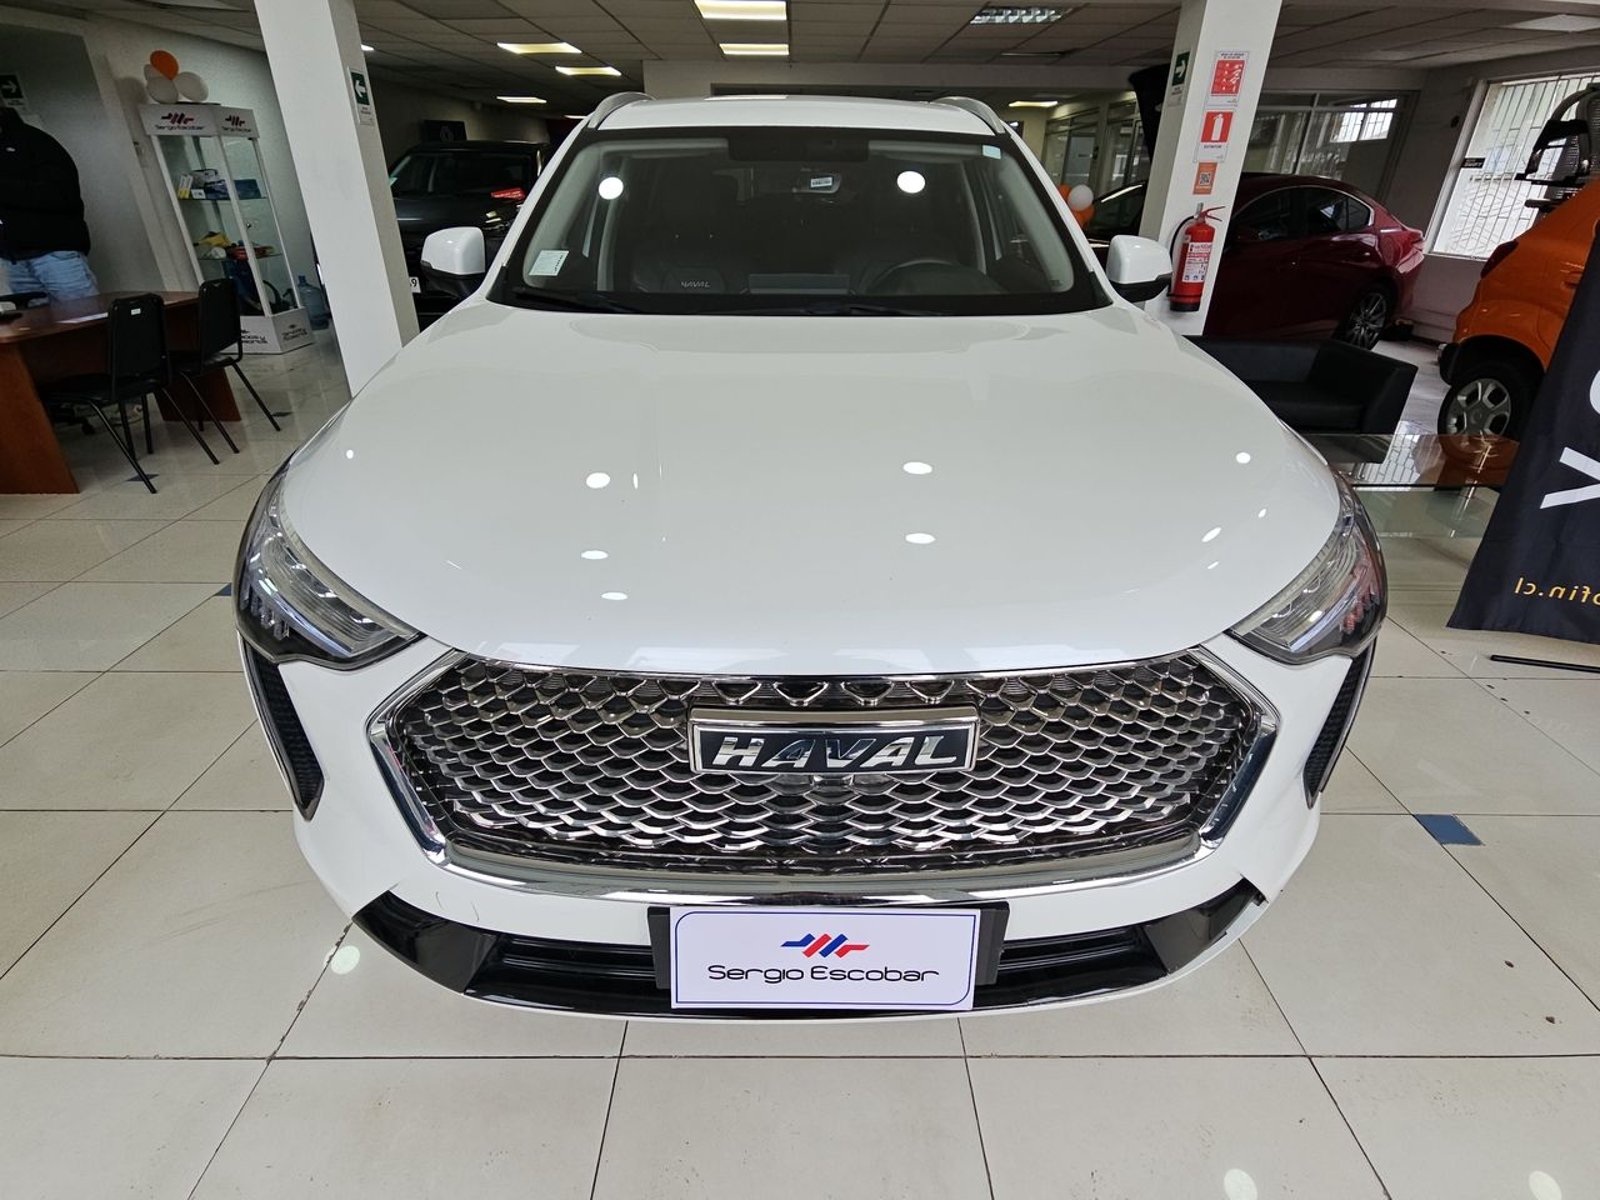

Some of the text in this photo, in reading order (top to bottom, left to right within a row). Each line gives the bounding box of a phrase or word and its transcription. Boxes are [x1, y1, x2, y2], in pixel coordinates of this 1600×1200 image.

[712, 735, 957, 768] HAVAL
[707, 964, 939, 984] Sergio Escobar
